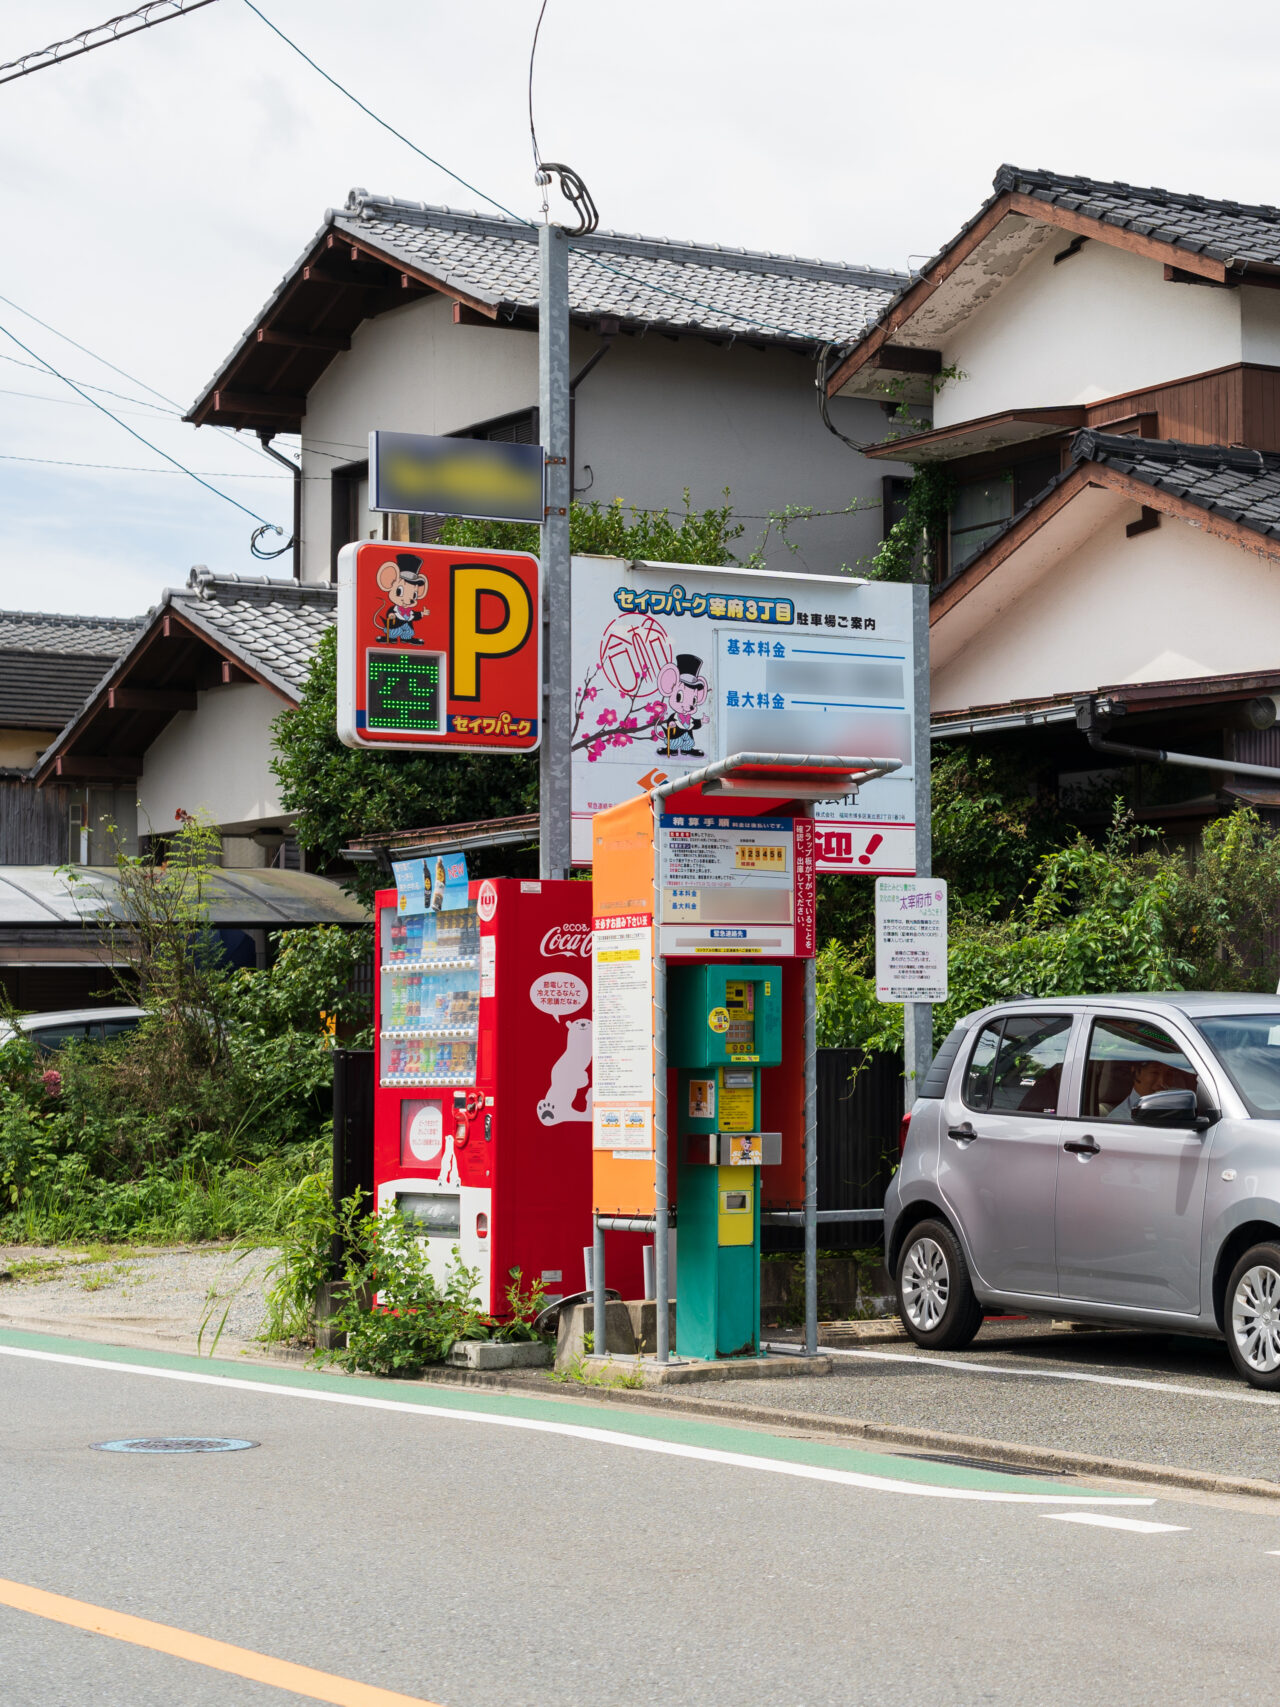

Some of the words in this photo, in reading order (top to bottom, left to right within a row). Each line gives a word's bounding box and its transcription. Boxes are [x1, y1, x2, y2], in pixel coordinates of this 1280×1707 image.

[796, 612, 876, 631] 駐車場ご案内
[450, 563, 534, 702] P
[727, 639, 785, 658] 基本料金
[726, 691, 785, 709] 最大料金
[452, 711, 532, 738] セイワパーク
[447, 863, 465, 879] NEW
[899, 891, 933, 911] 太宰府市
[537, 989, 581, 997] 冷えてるなんて
